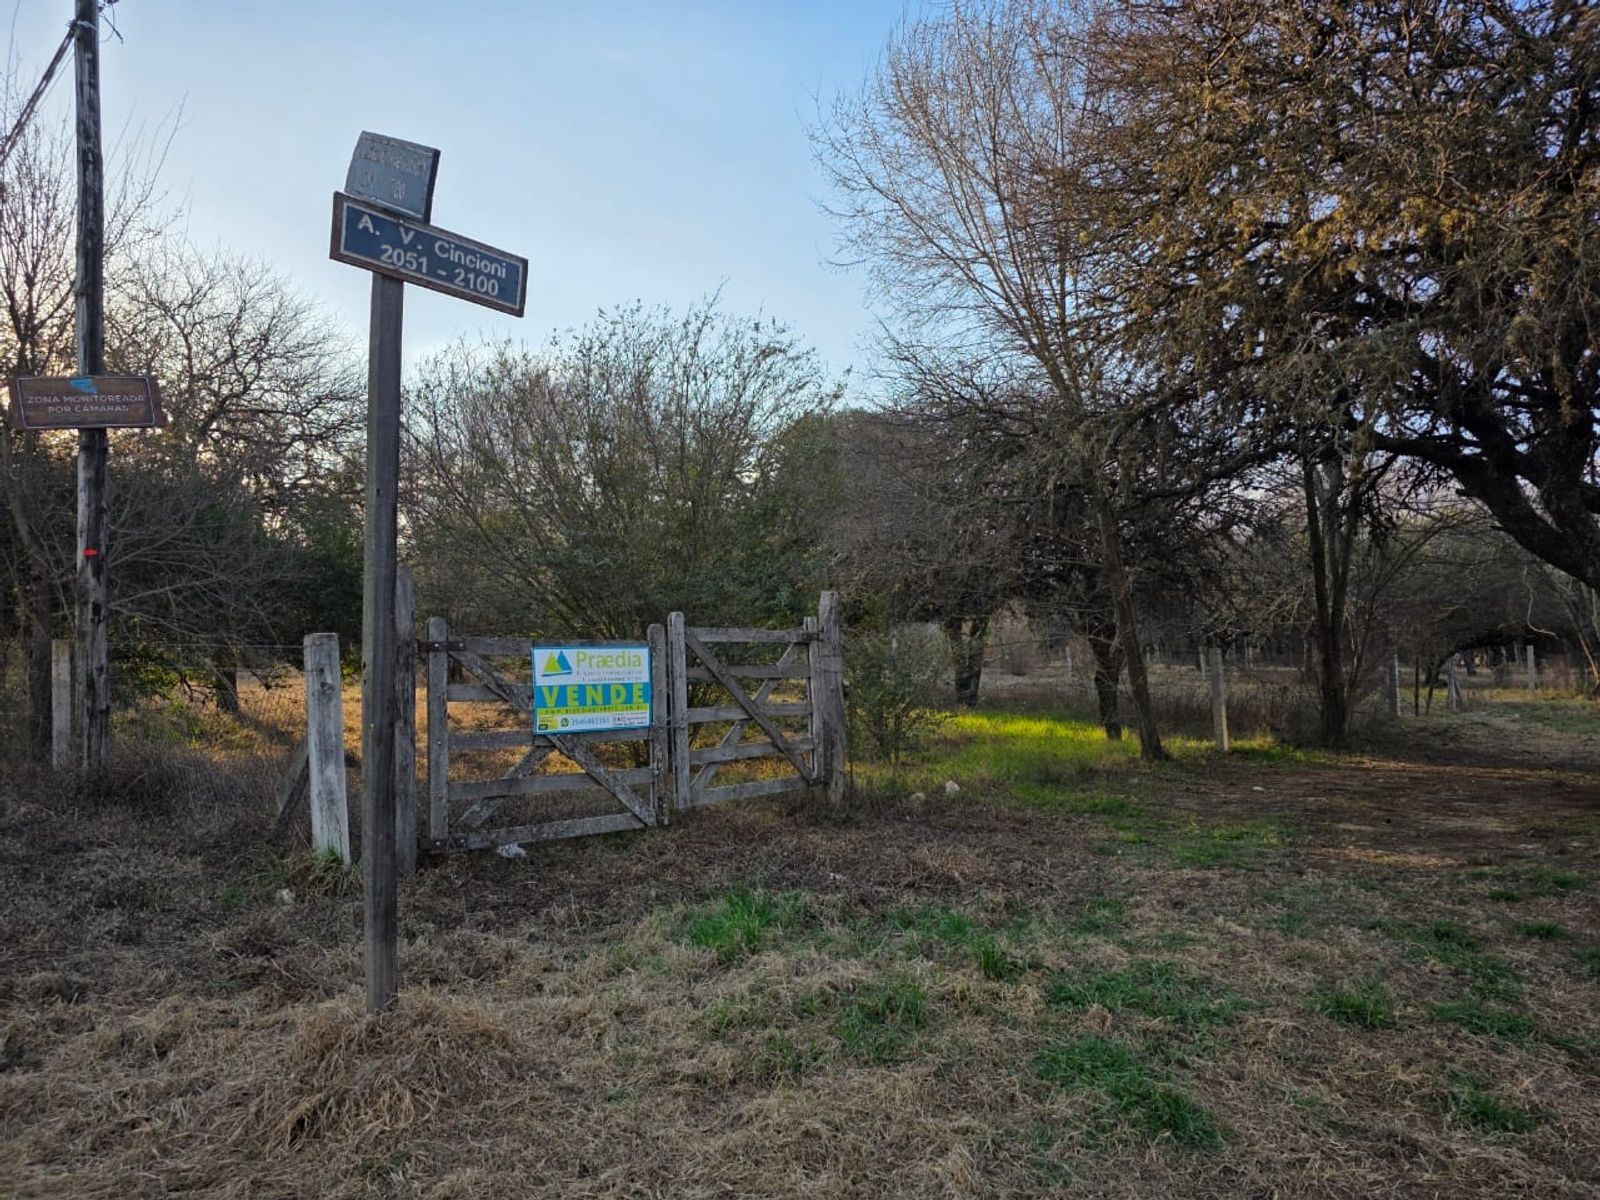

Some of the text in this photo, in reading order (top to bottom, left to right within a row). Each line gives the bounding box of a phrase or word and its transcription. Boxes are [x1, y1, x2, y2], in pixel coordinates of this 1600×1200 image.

[357, 214, 507, 279] A. V. Cincioni
[380, 244, 428, 274] 2051
[453, 268, 499, 296] 2100
[27, 394, 145, 404] ZONA MONITOREADA
[48, 406, 71, 414] POR
[541, 683, 644, 707] VENDE
